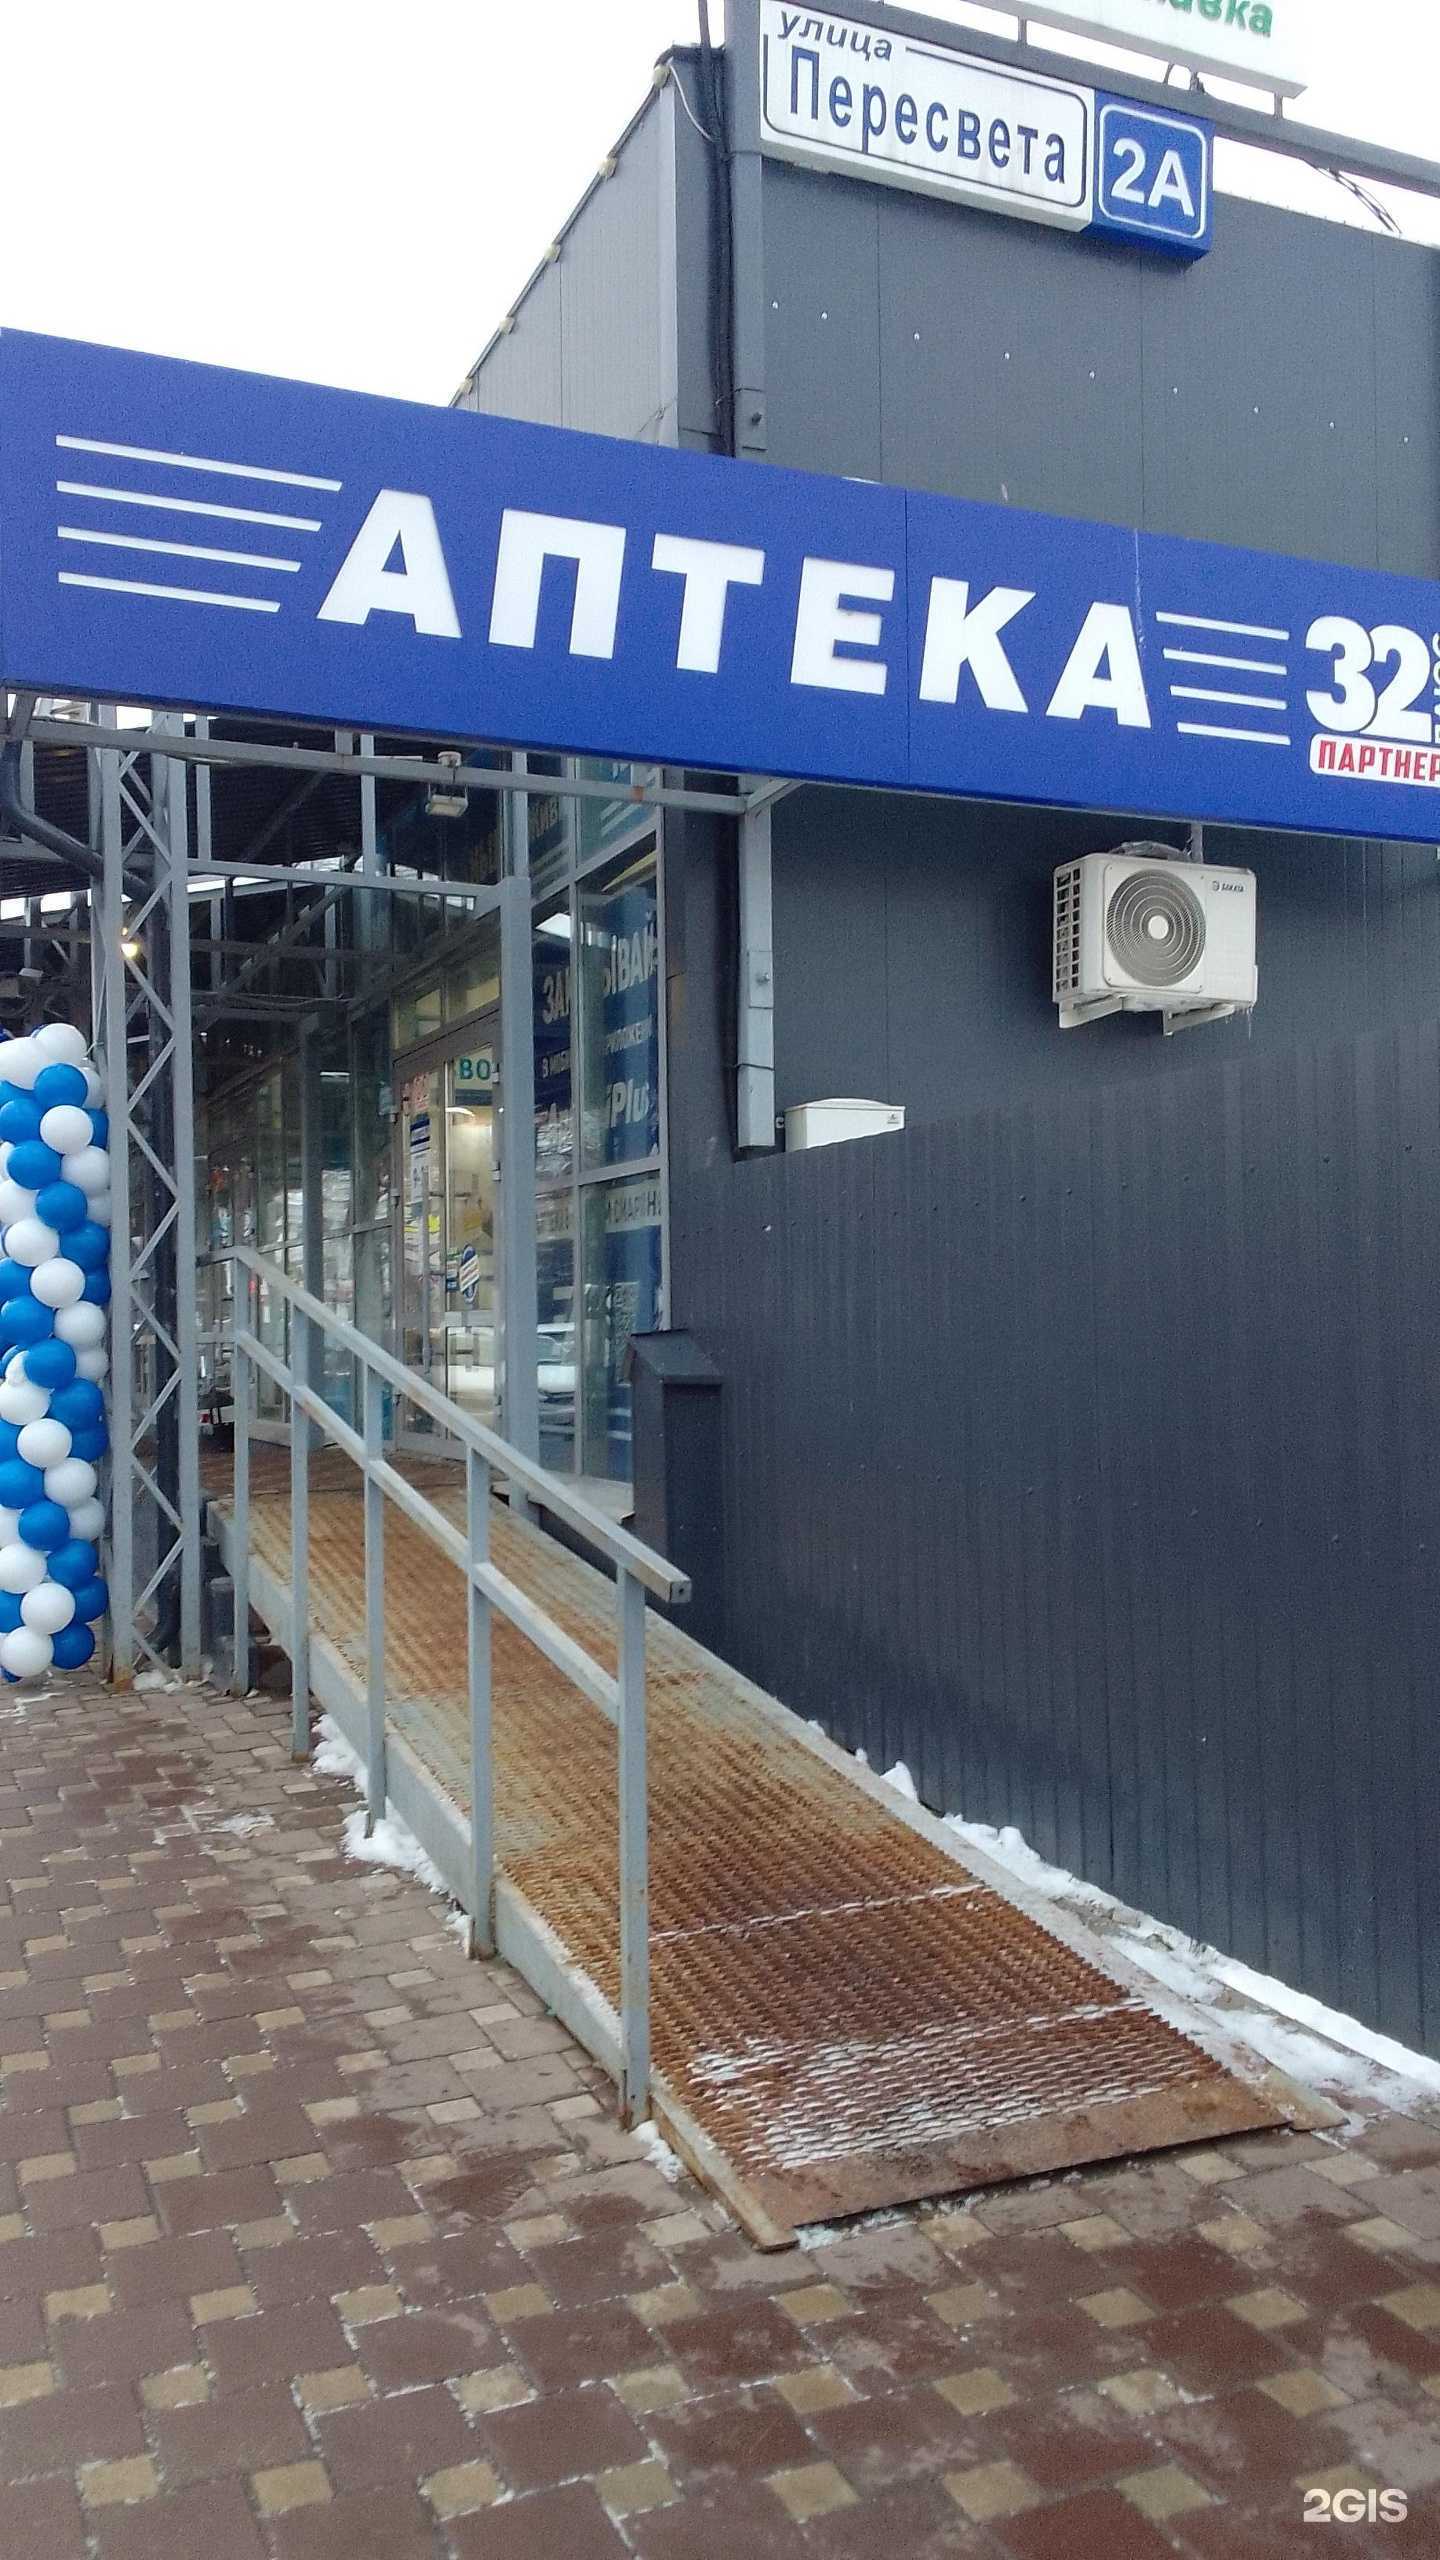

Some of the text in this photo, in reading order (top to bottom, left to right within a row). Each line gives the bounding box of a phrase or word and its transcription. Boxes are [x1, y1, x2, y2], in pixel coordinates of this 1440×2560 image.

[777, 10, 893, 61] улица
[788, 46, 1195, 218] Пересвета 2А
[316, 487, 1152, 729] АПТЕКА
[1305, 615, 1433, 743] 32
